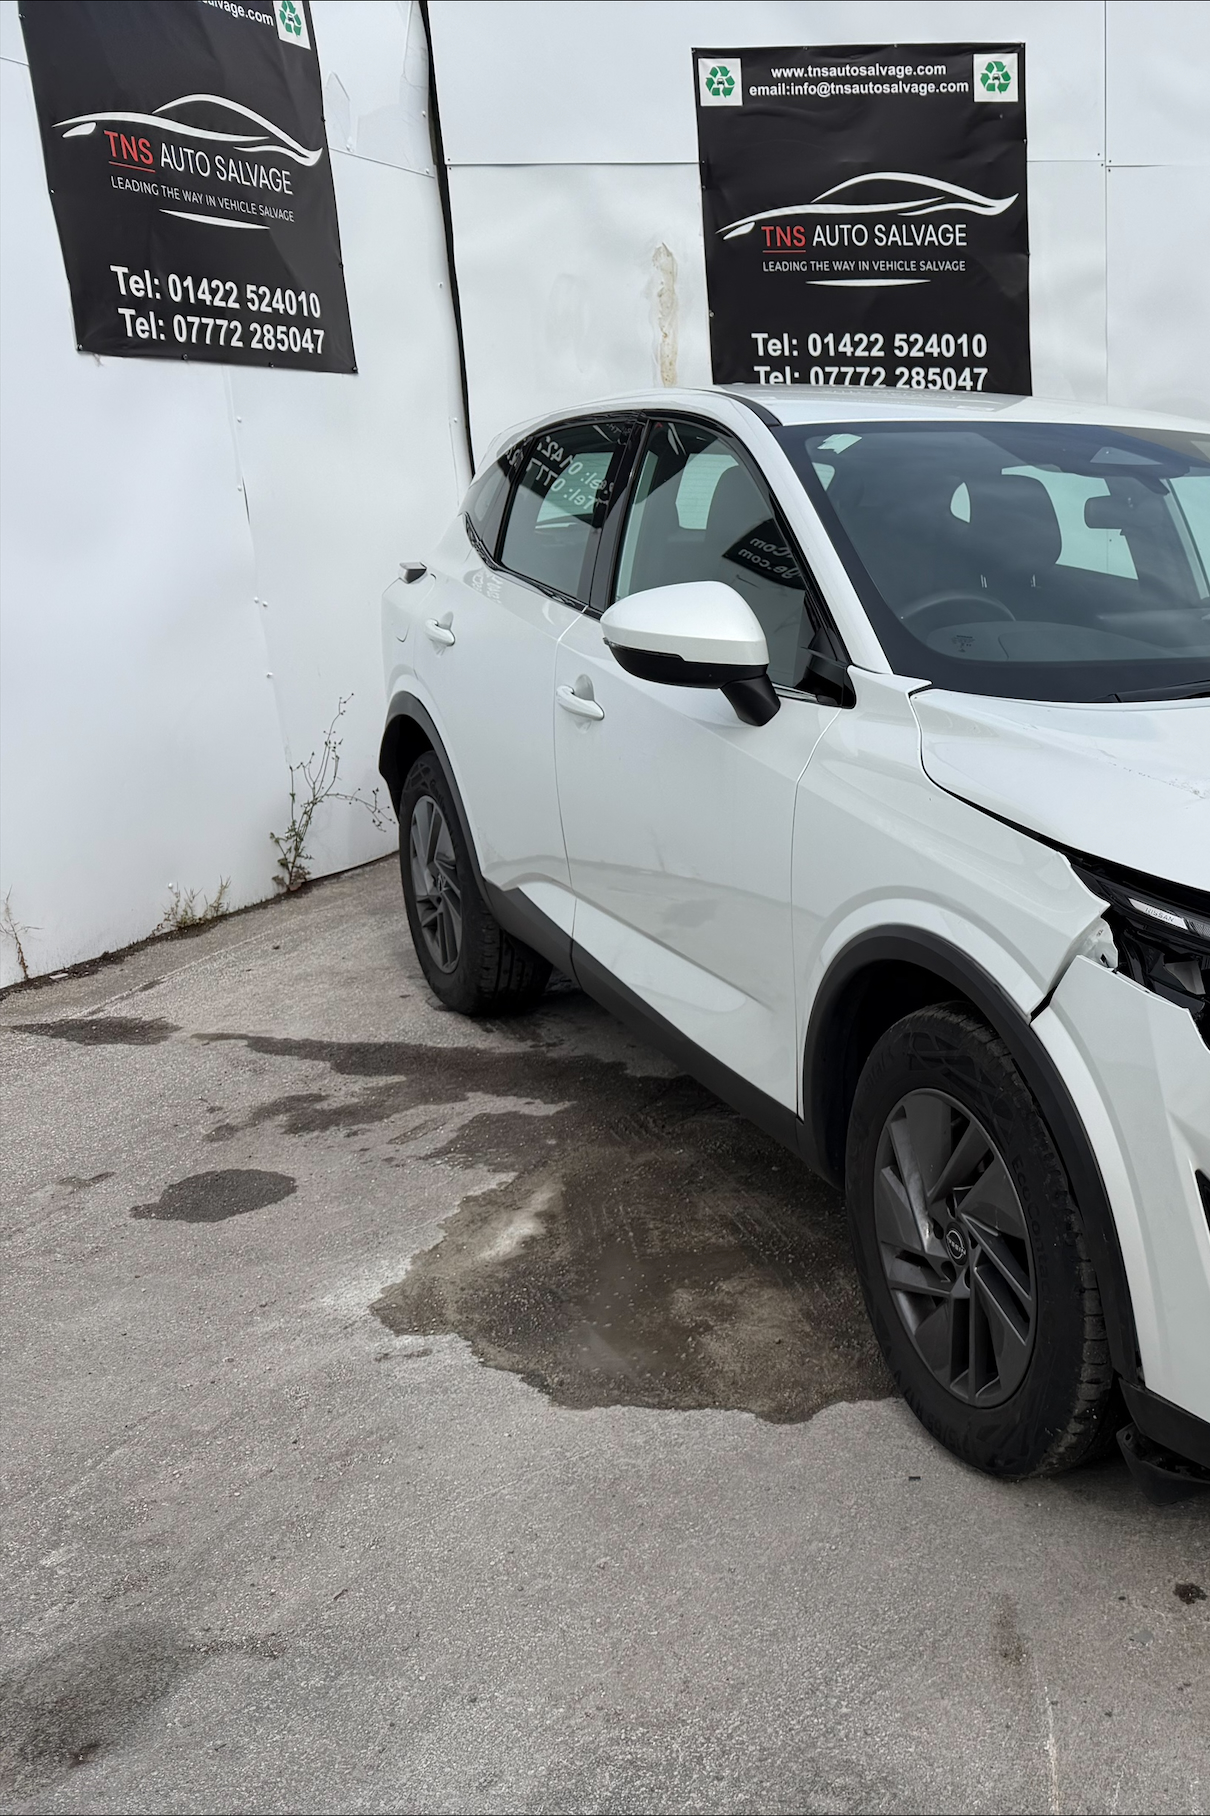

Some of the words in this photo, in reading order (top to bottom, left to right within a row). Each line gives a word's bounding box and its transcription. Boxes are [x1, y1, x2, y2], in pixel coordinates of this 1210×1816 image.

[771, 63, 946, 78] www.tnsautosalvage.com
[750, 81, 968, 97] email:info@tnsautosalvage.com
[104, 131, 153, 166] TNS
[161, 143, 210, 177] AUTO
[215, 156, 293, 195] SALVAGE
[111, 176, 158, 195] LEADING
[161, 185, 180, 200] THE
[182, 190, 202, 204] WAY
[206, 195, 216, 206] IN
[218, 197, 257, 214] VEHICLE
[259, 205, 294, 222] SALVAGE
[762, 226, 805, 246] TNS
[813, 225, 868, 246] AUTO
[875, 224, 966, 246] SALVAGE
[763, 262, 807, 271] LEADING
[810, 261, 829, 270] THE
[833, 261, 855, 270] WAY
[859, 261, 869, 270] IN
[872, 261, 916, 270] VEHICLE
[920, 261, 965, 270] SALVAGE
[110, 265, 160, 299] Tel:
[168, 274, 240, 308] 01422
[247, 285, 320, 318] 524010
[118, 308, 165, 340] Tel:
[174, 315, 243, 347] 07772
[250, 323, 324, 354] 285047
[751, 333, 798, 356] Tel:
[808, 333, 884, 356] 01422
[894, 334, 986, 357] 524010
[809, 366, 887, 387] 07772
[894, 367, 988, 391] 285047
[1145, 907, 1175, 923] NISSAN
